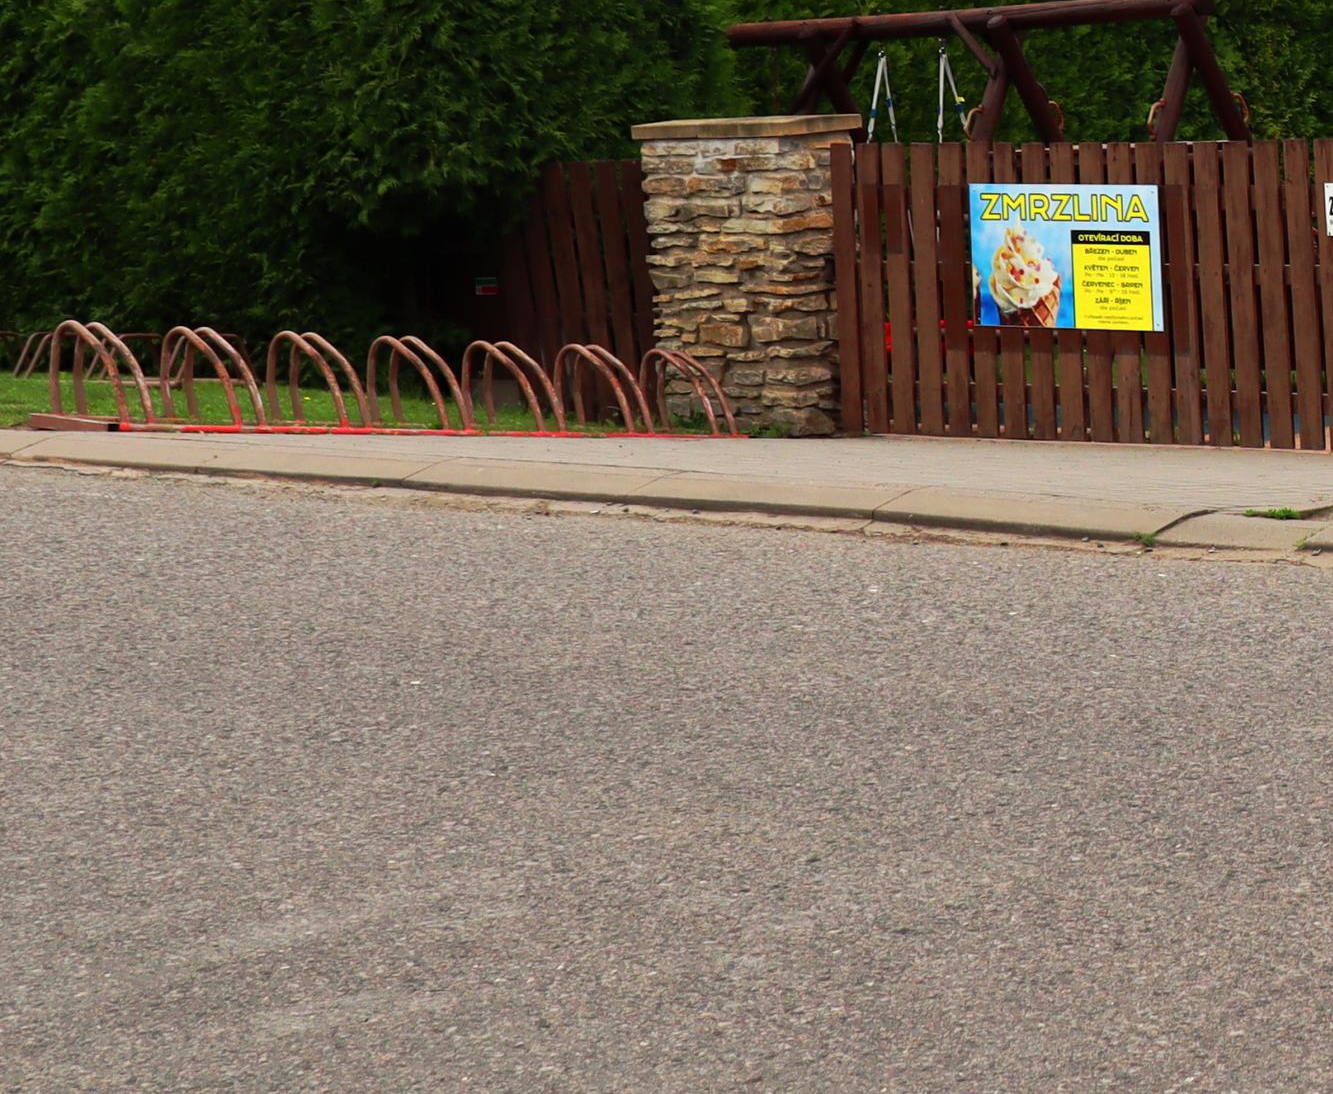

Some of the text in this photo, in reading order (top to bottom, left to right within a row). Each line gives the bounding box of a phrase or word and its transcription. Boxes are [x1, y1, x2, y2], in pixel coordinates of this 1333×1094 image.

[980, 192, 1149, 223] ZMRZLINA
[1078, 233, 1143, 243] OTEVÍRACÍ DOBA
